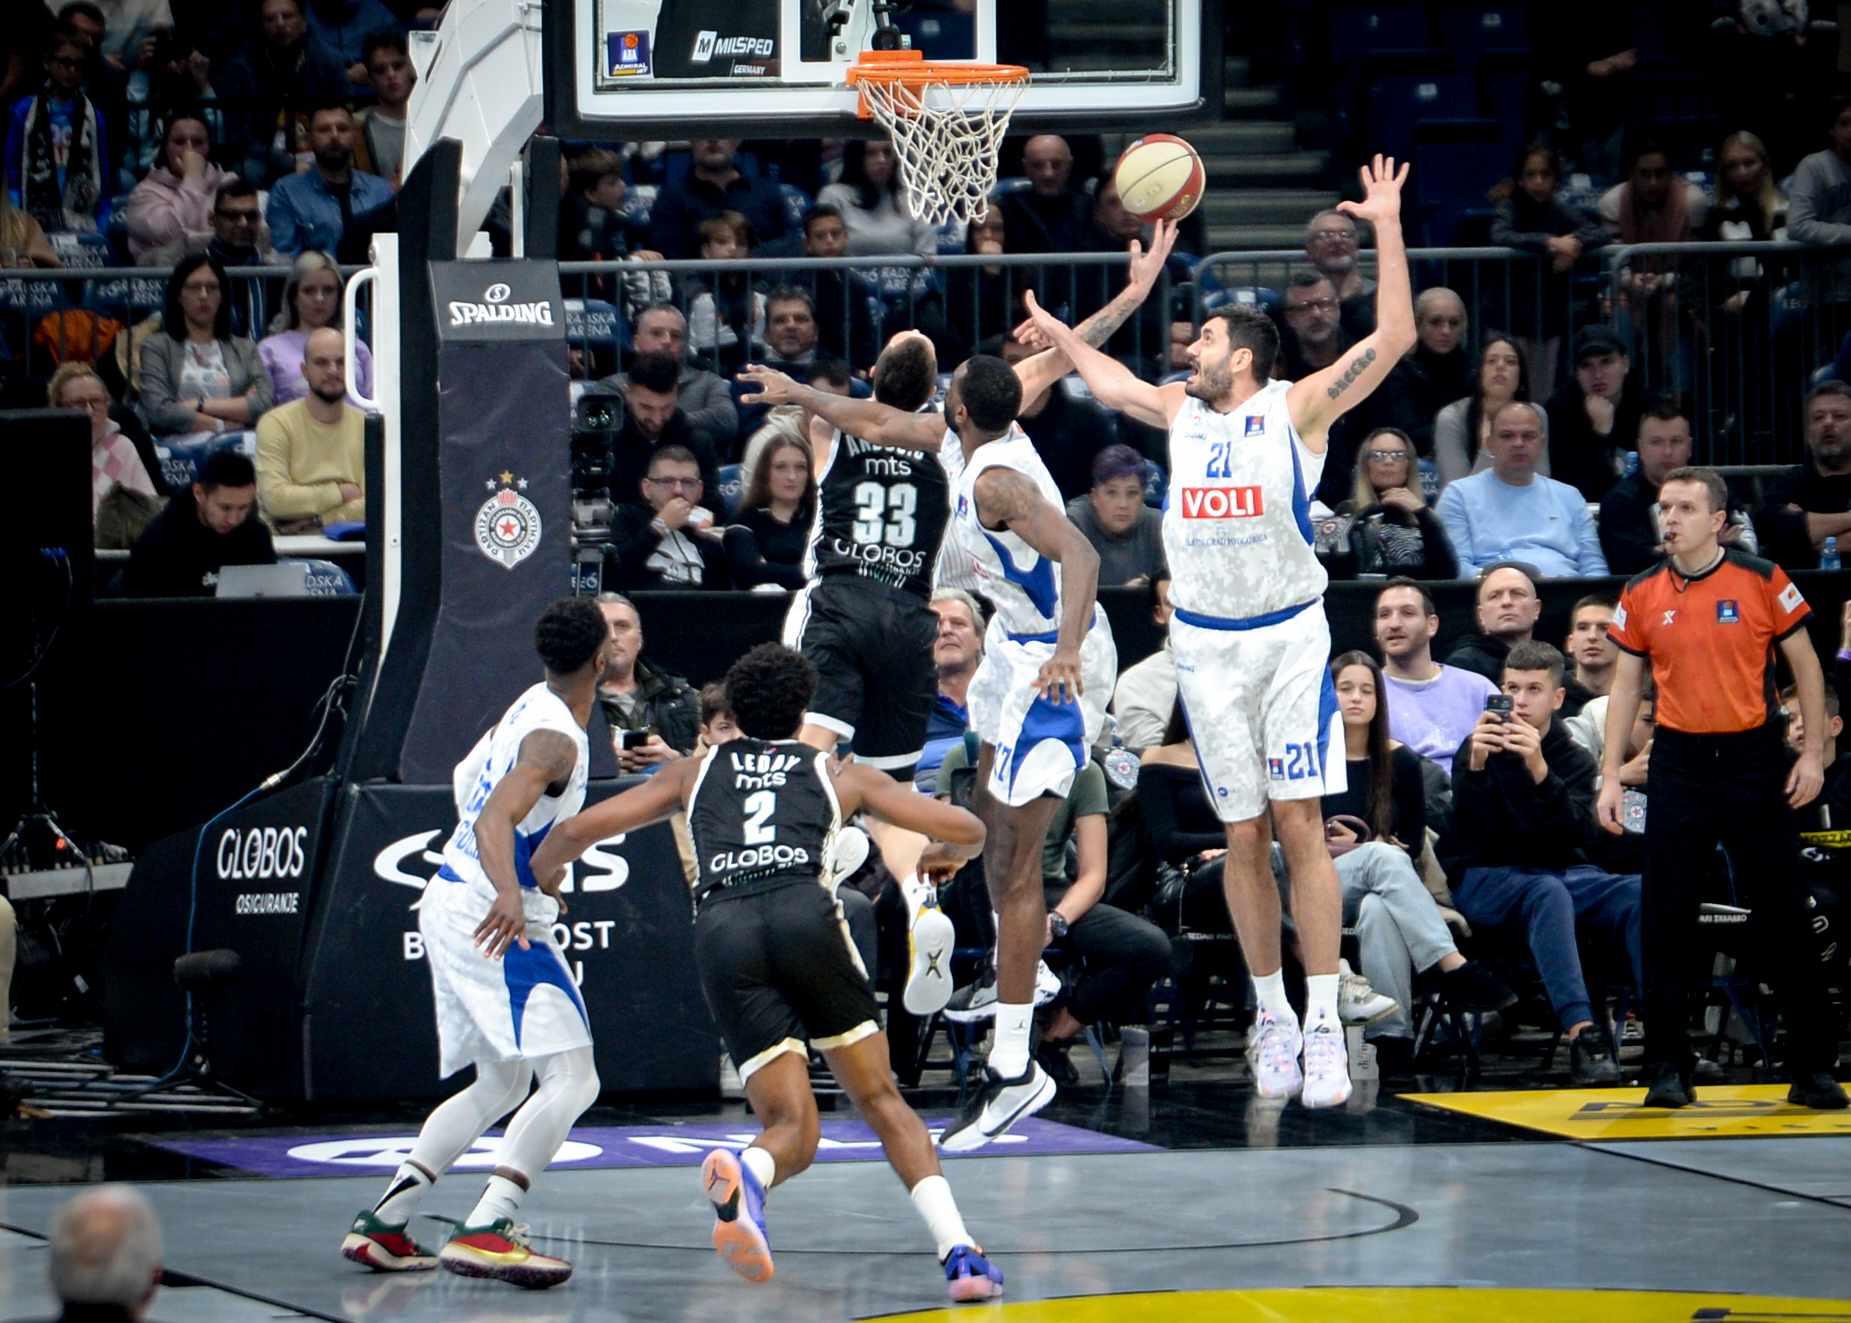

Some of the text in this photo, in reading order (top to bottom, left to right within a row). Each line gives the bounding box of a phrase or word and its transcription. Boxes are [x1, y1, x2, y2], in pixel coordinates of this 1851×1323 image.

[733, 64, 766, 75] GERMANY
[450, 301, 554, 326] SPALDING
[865, 456, 912, 476] mts
[1206, 441, 1232, 478] 21
[853, 481, 918, 548] 33
[1184, 488, 1255, 518] VOLI
[834, 538, 926, 567] GLOBOS
[731, 752, 801, 773] LEDAY
[1286, 741, 1318, 780] 21
[736, 772, 787, 789] mts
[744, 790, 776, 845] 2
[217, 826, 307, 879] GLOBOS
[710, 845, 809, 873] GLOBOS
[235, 892, 299, 914] OSIGURANJE
